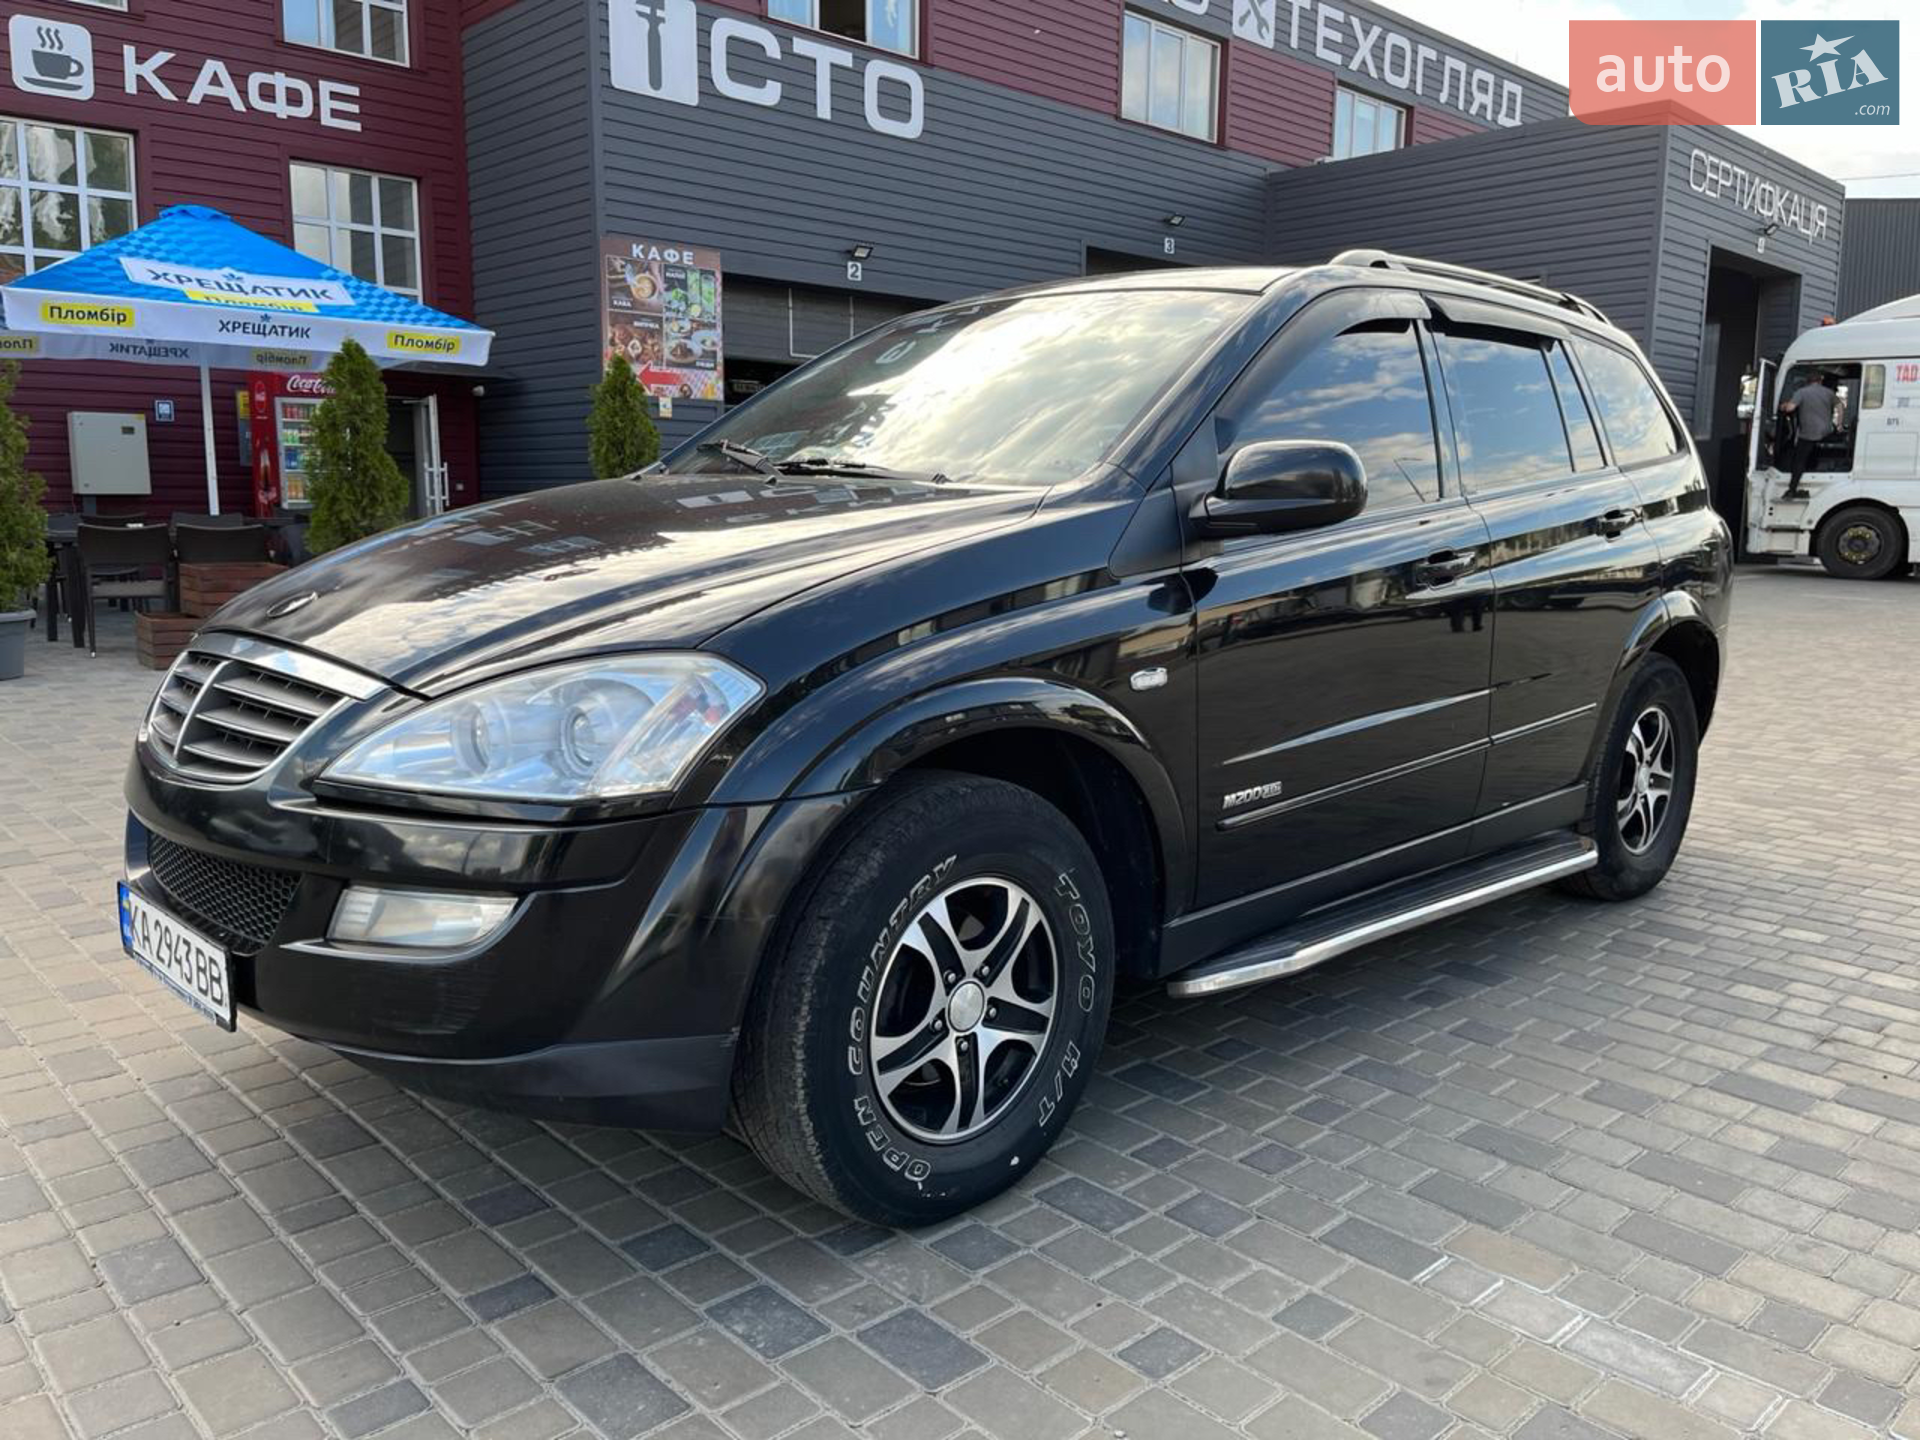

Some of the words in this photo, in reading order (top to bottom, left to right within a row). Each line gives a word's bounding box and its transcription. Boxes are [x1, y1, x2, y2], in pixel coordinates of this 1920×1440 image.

[122, 43, 363, 132] КАФЕ
[711, 17, 925, 139] СТО
[1288, 0, 1524, 127] ТЕХОГЛЯД
[146, 267, 334, 301] ХРЕЩАТИК
[632, 243, 694, 265] КАФЕ
[850, 264, 859, 279] 2
[49, 305, 128, 325] Пломбір
[218, 319, 311, 340] ХРЕЩАТИК
[394, 334, 456, 353] Пломбір
[848, 854, 957, 1076] COUNTRY
[1054, 872, 1096, 1012] TOYO
[853, 1096, 931, 1182] OPEN
